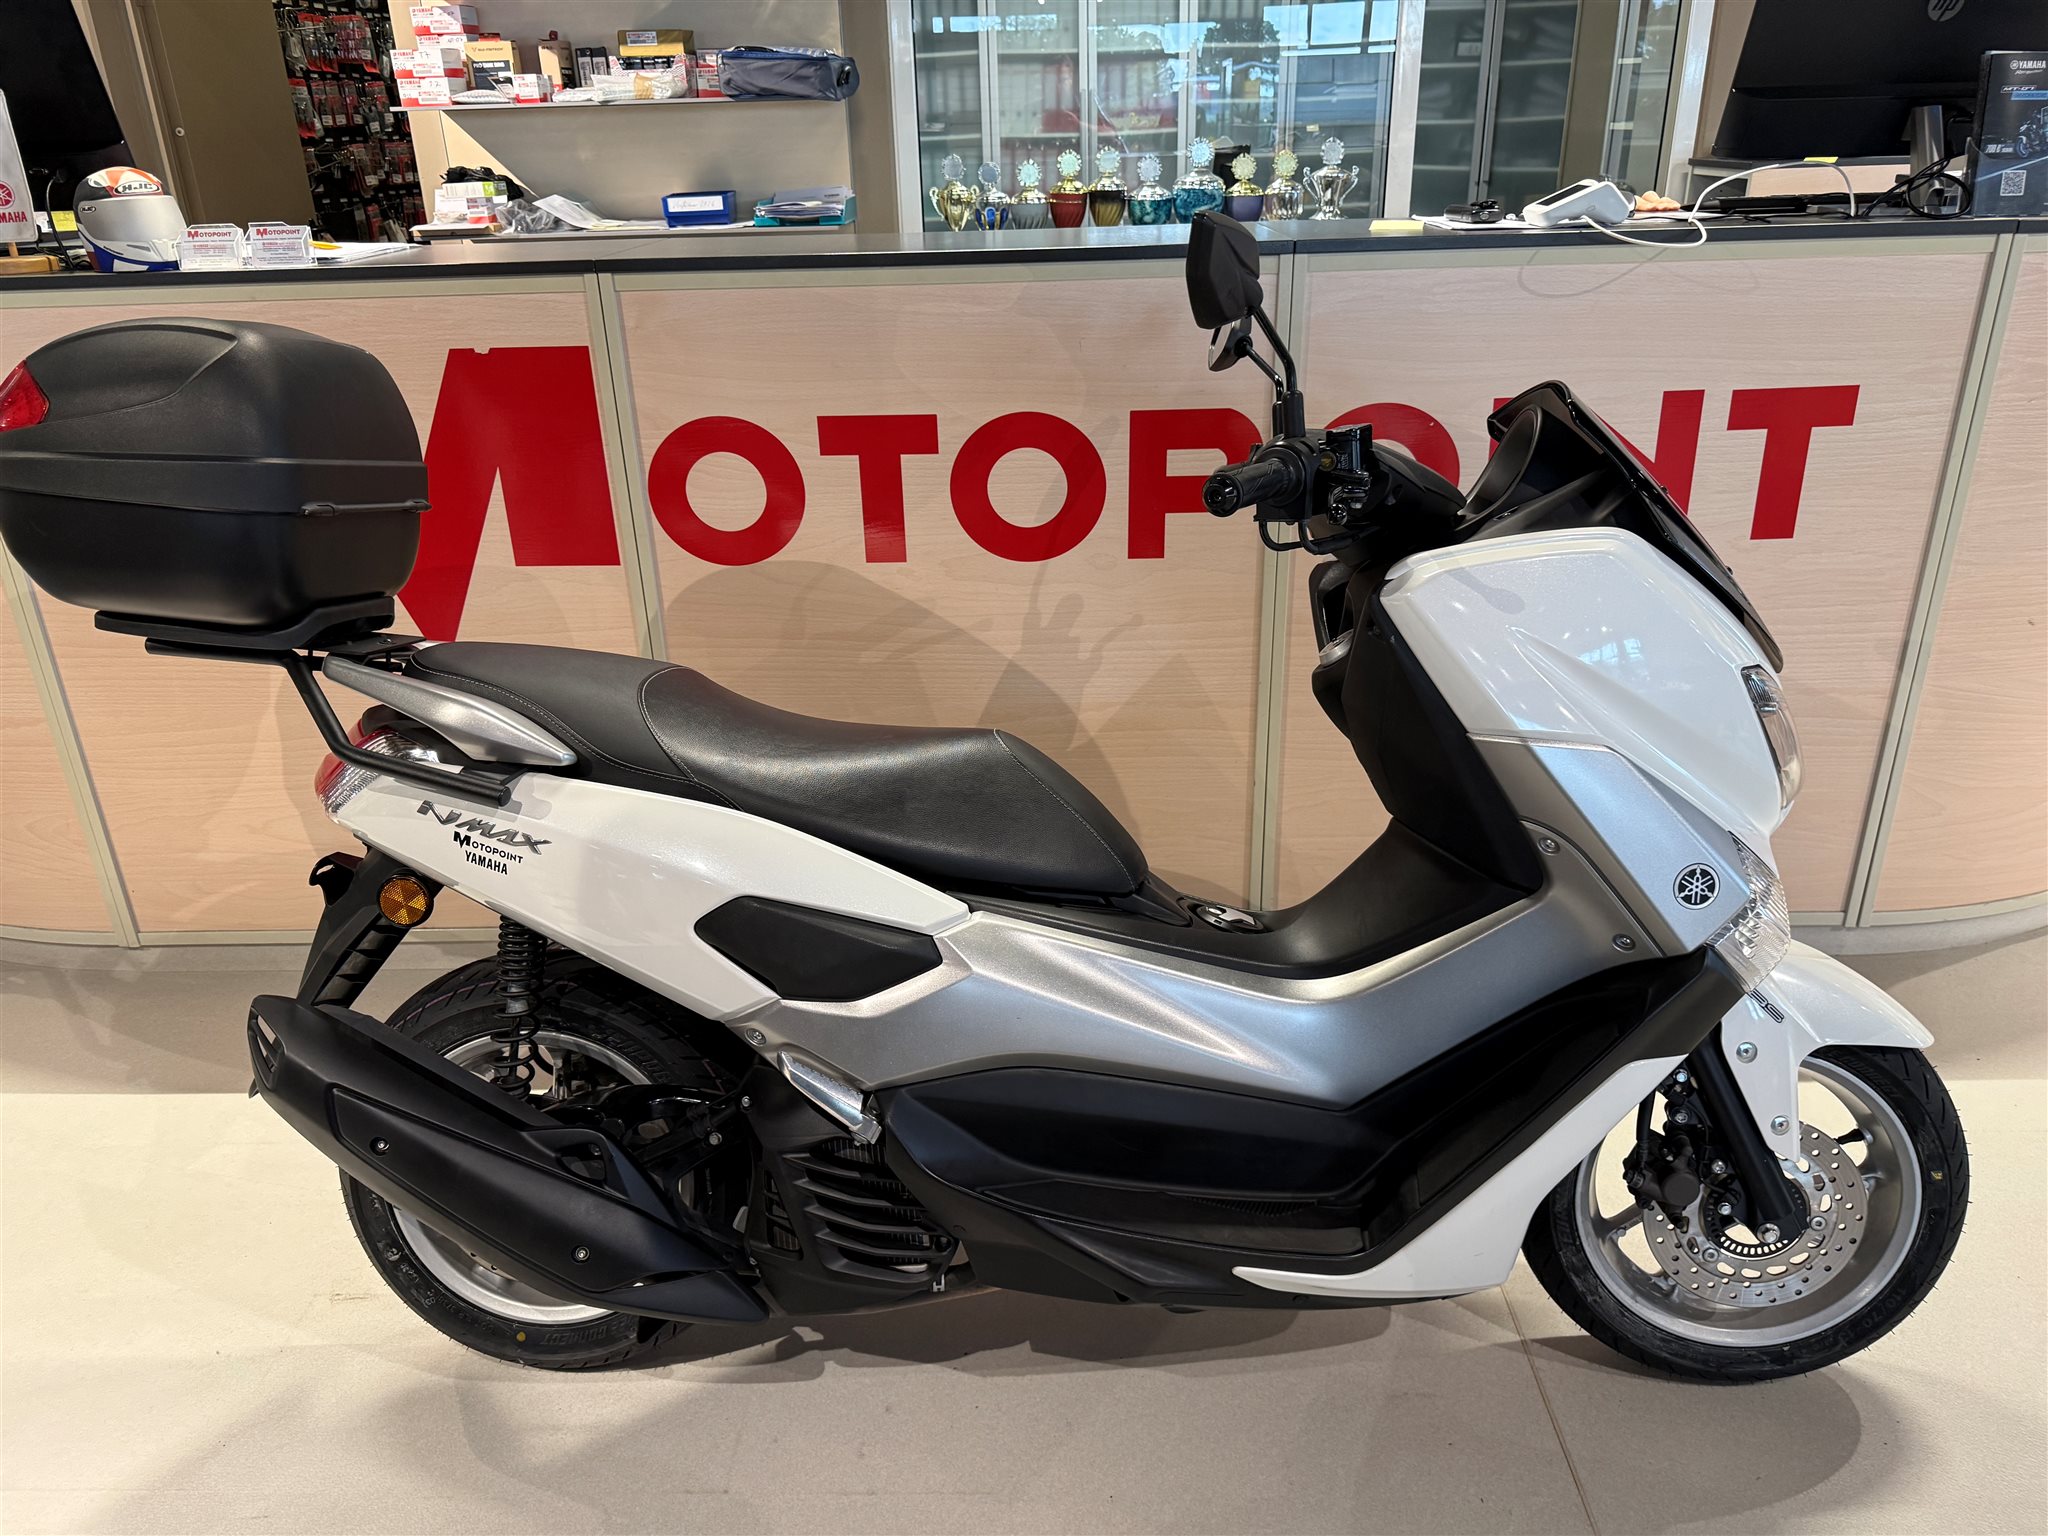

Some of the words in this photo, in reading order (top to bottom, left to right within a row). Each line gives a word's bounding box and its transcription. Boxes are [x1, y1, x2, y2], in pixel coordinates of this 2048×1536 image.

[2019, 60, 2047, 69] YAMAHA
[122, 183, 154, 193] HJC
[0, 211, 28, 223] MAHA
[187, 230, 232, 240] MOTOPOINT
[256, 228, 301, 239] MOTOPOINT
[396, 345, 1860, 642] MOTOPT
[416, 799, 553, 855] NMAX
[453, 830, 524, 864] MOTOPOINT
[465, 850, 508, 875] YAMAHA
[1745, 987, 1785, 1024] BS
